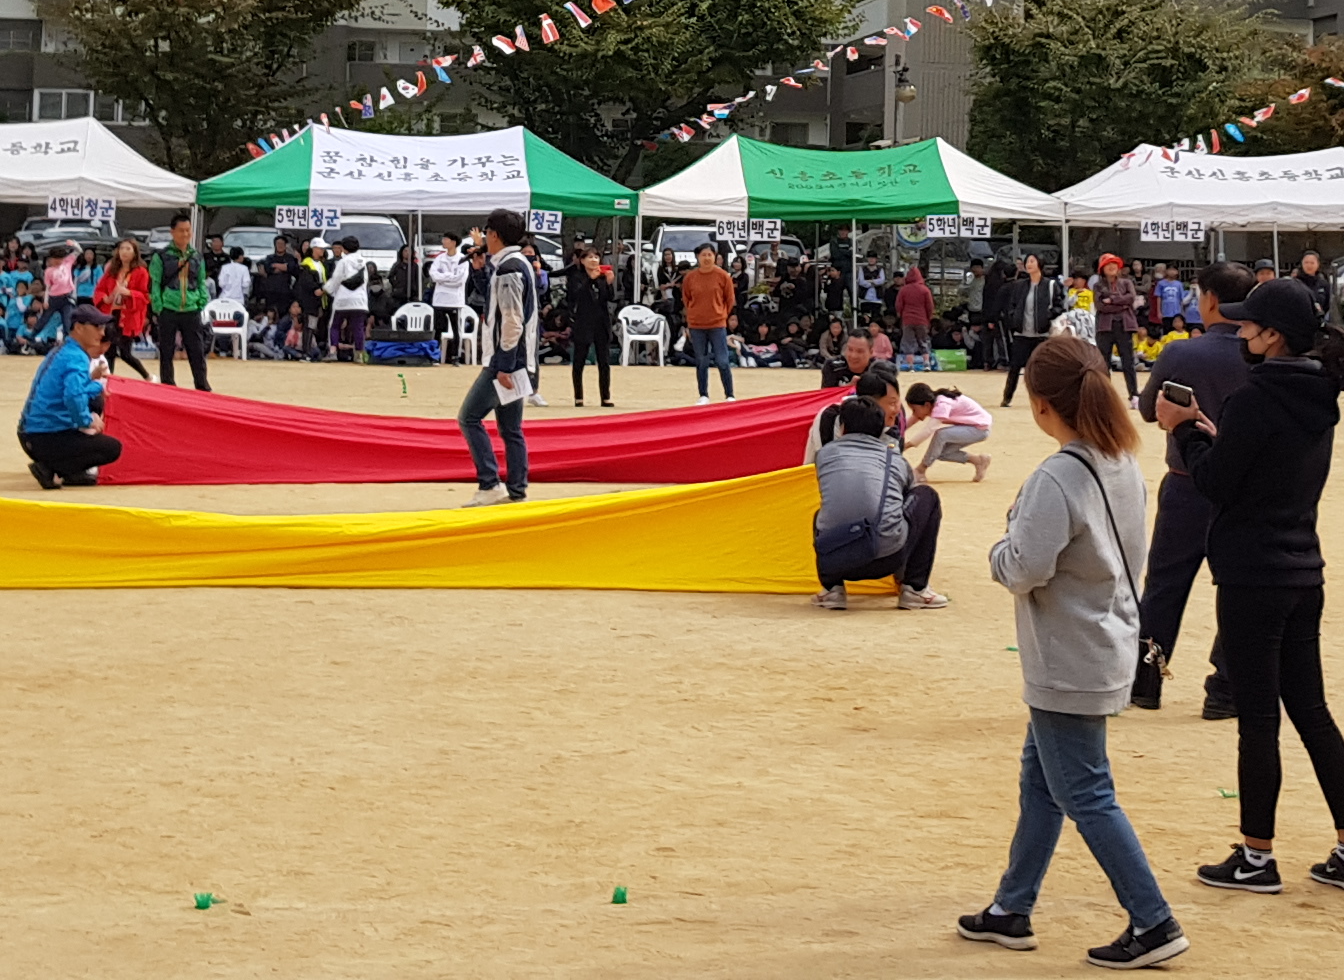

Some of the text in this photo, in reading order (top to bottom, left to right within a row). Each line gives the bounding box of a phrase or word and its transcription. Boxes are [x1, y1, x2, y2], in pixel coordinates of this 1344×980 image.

[448, 154, 520, 169] 가꾸는
[49, 196, 115, 218] 4학년 청군
[276, 208, 340, 228] 5학년 청군
[532, 211, 559, 231] 청군
[928, 216, 990, 237] 5학년 백군
[717, 220, 780, 239] 6학년 백군
[1142, 222, 1204, 240] 4학년 백군
